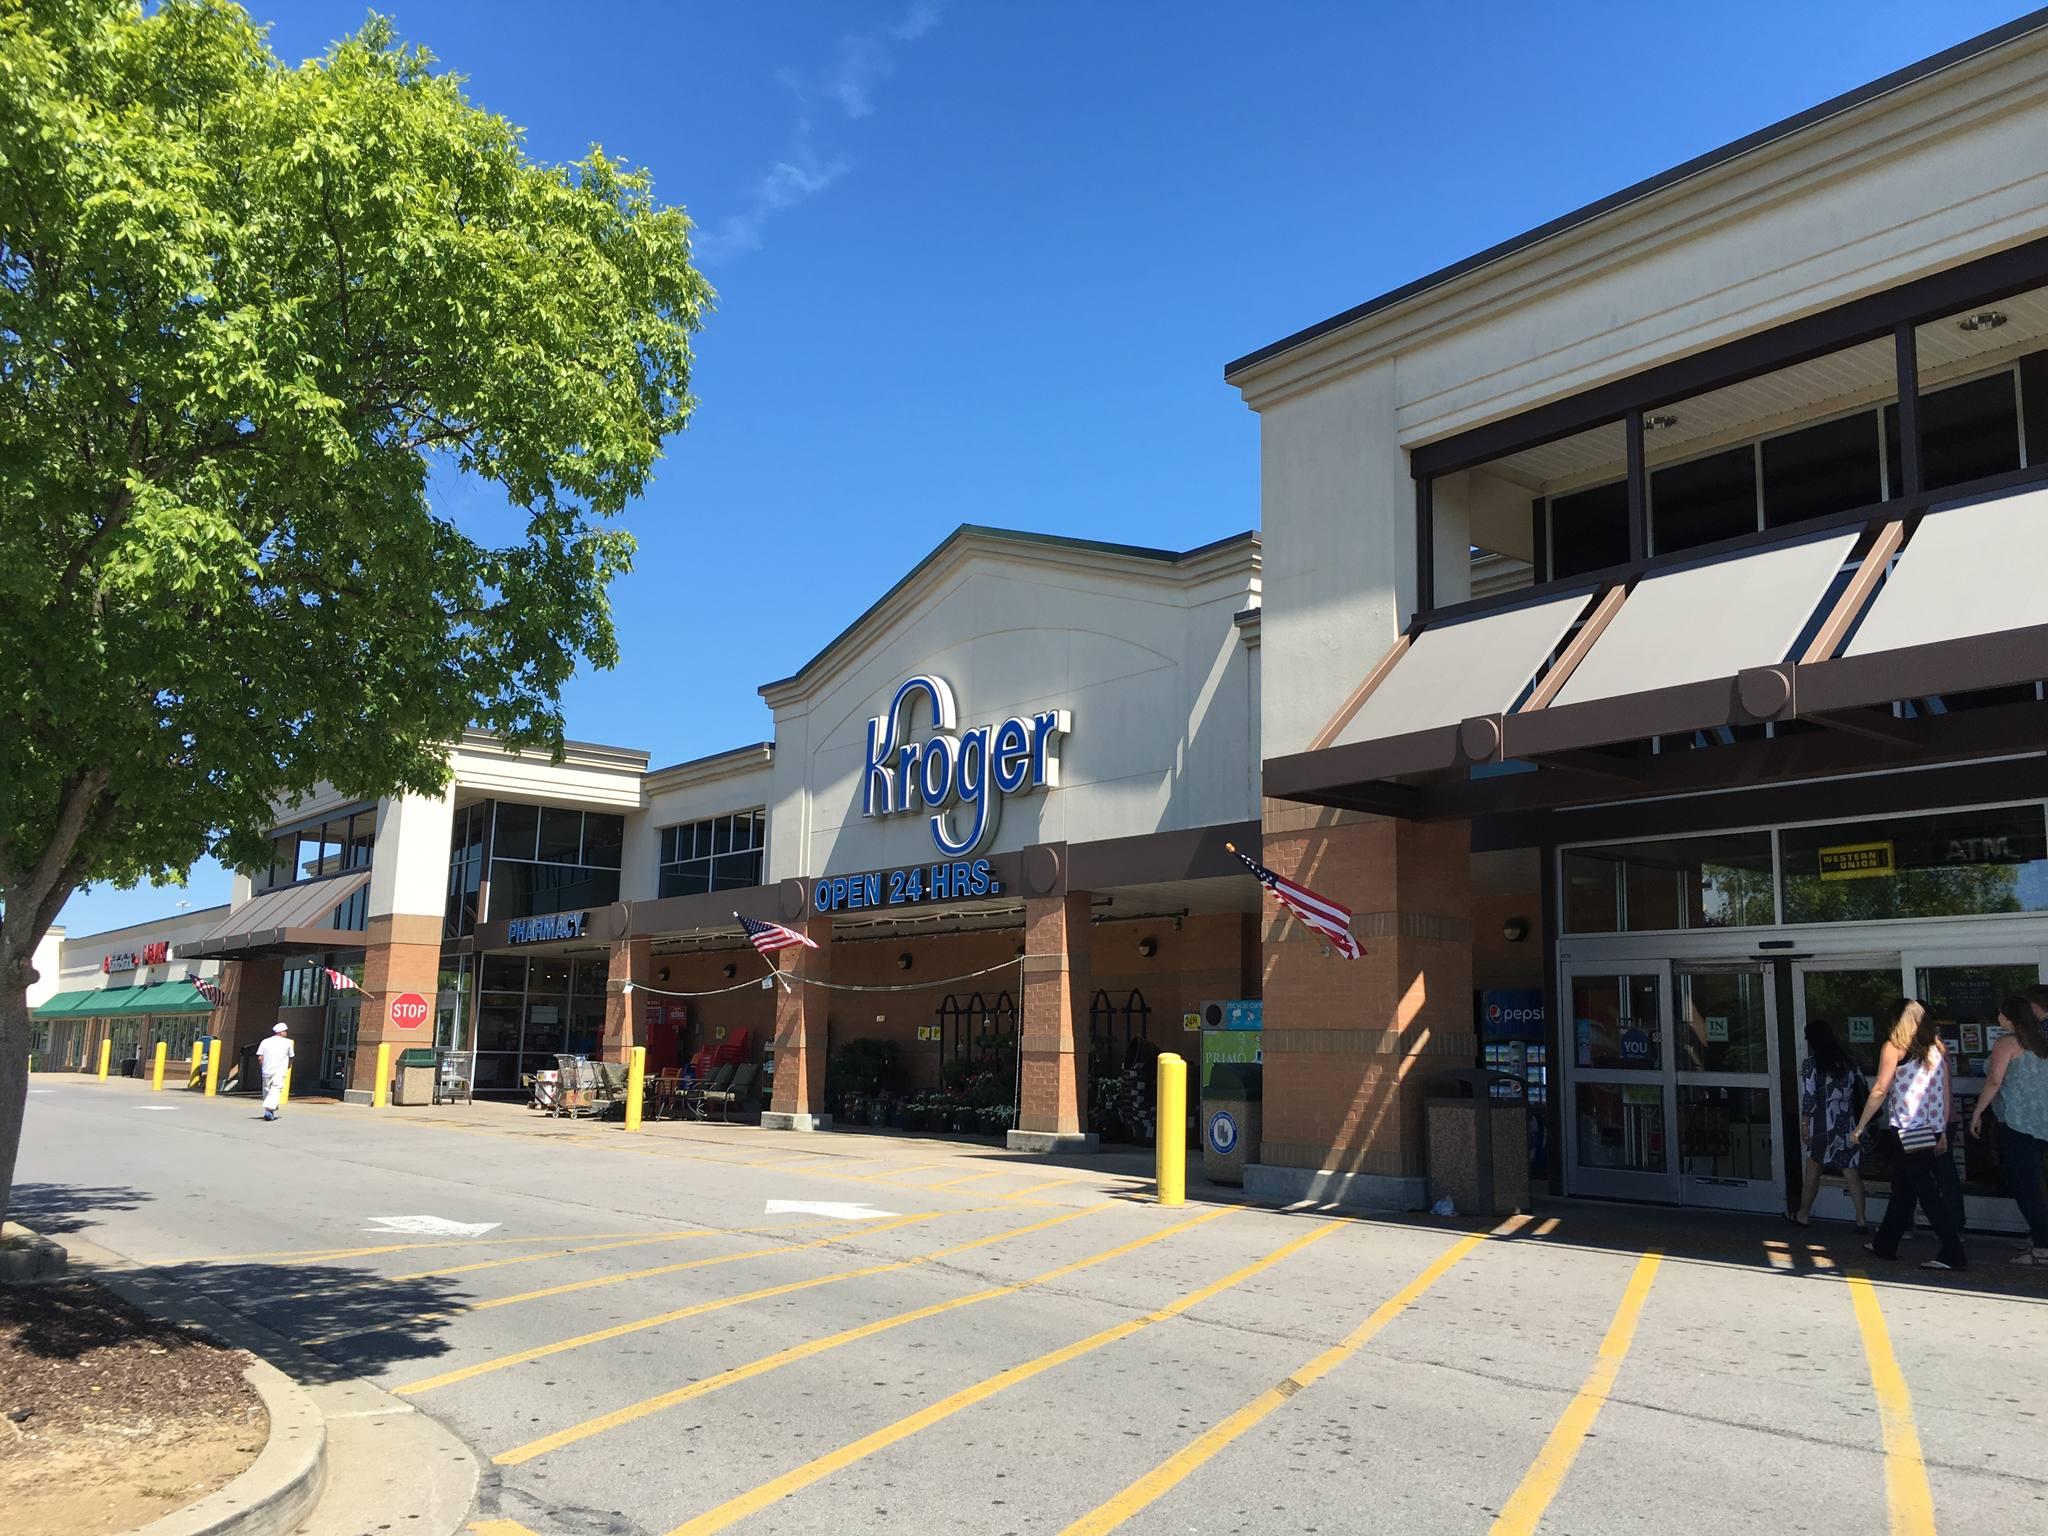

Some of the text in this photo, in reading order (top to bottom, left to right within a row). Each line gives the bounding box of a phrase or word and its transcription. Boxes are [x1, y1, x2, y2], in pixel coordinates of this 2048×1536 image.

[862, 674, 1071, 858] Kroger
[1945, 837, 2009, 861] ATM
[1823, 850, 1877, 864] WESTERN
[1839, 859, 1877, 869] UNION
[815, 872, 881, 912] OPEN
[507, 911, 584, 944] PHARMACY
[393, 1003, 426, 1018] STOP
[1504, 1006, 1545, 1023] pepsi
[1709, 1020, 1724, 1031] IN
[1854, 1020, 1869, 1031] IN
[1623, 1041, 1648, 1054] YOU
[1206, 1052, 1247, 1064] PRIMO
